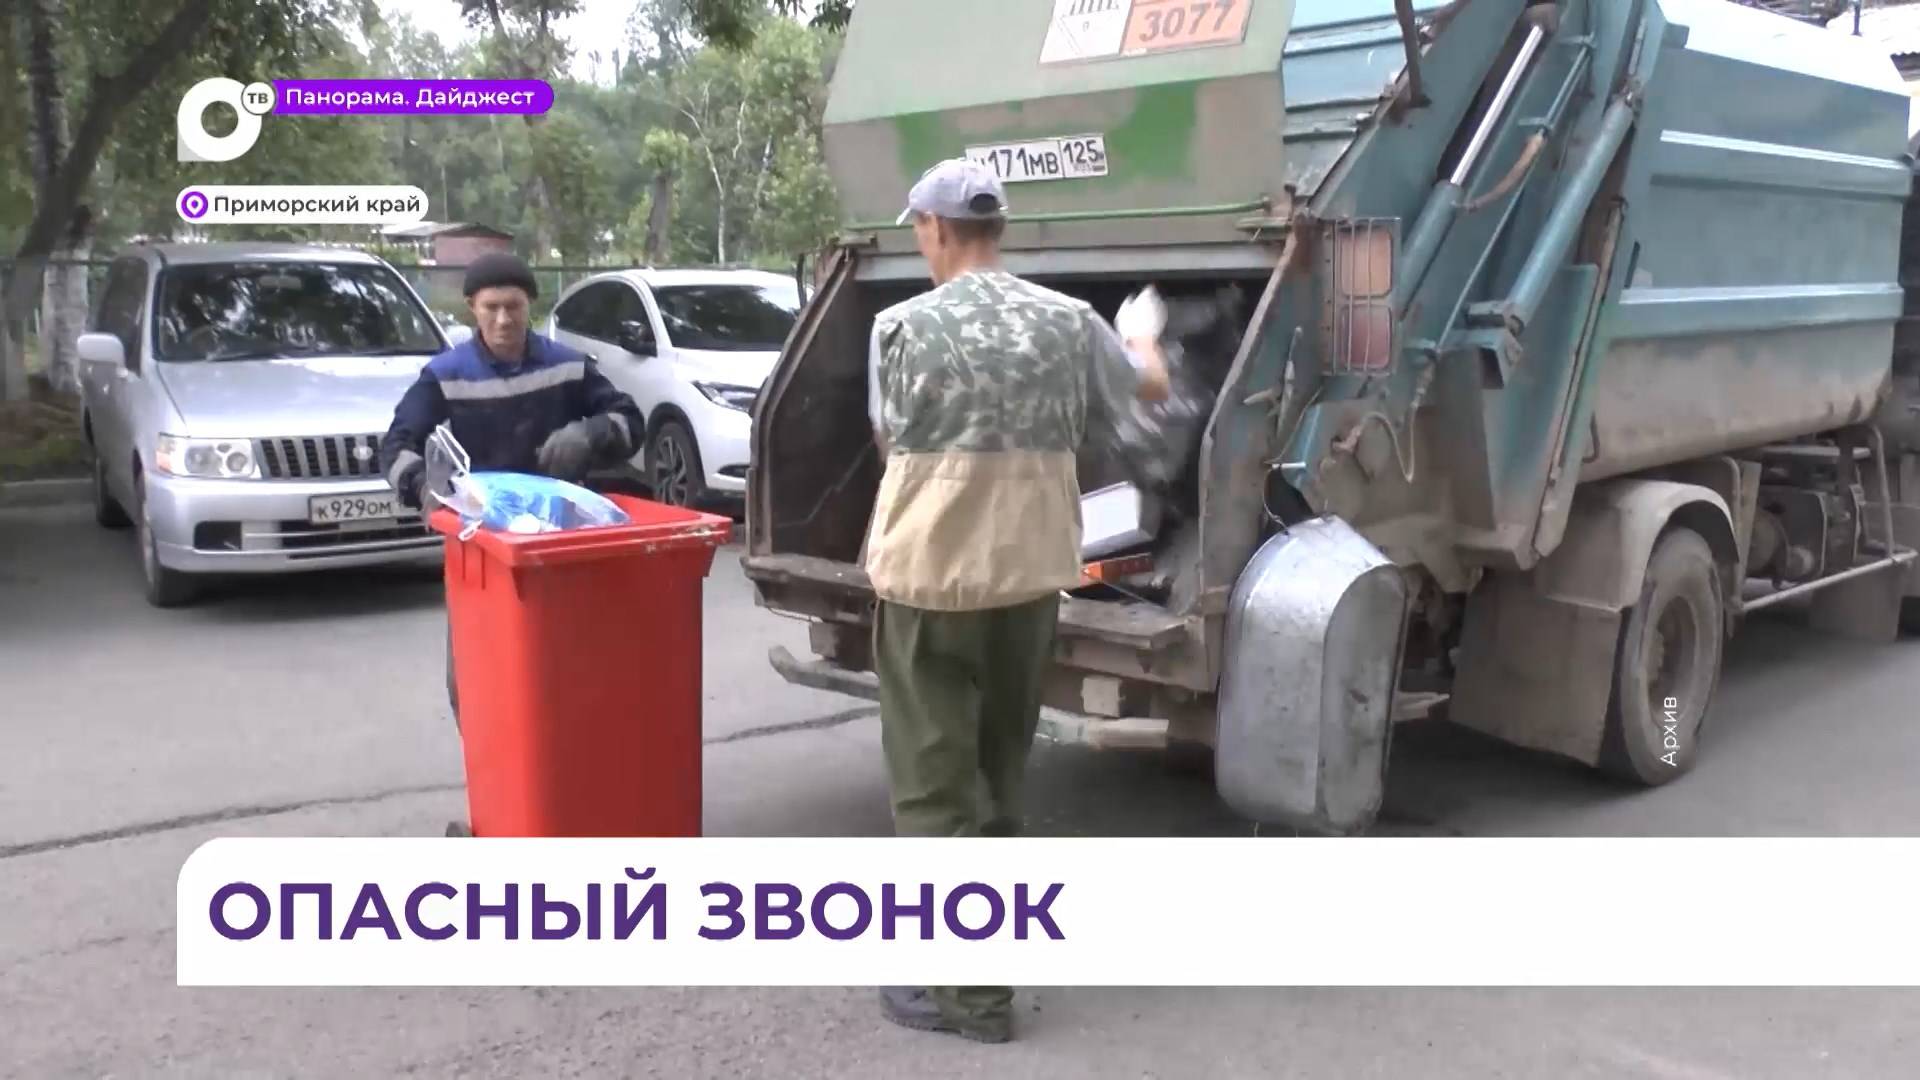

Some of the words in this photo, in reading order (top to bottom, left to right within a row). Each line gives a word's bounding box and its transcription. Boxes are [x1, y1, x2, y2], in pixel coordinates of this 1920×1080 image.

[1139, 0, 1235, 42] 3077
[973, 147, 1059, 177] 171МВ
[1063, 140, 1098, 164] 125
